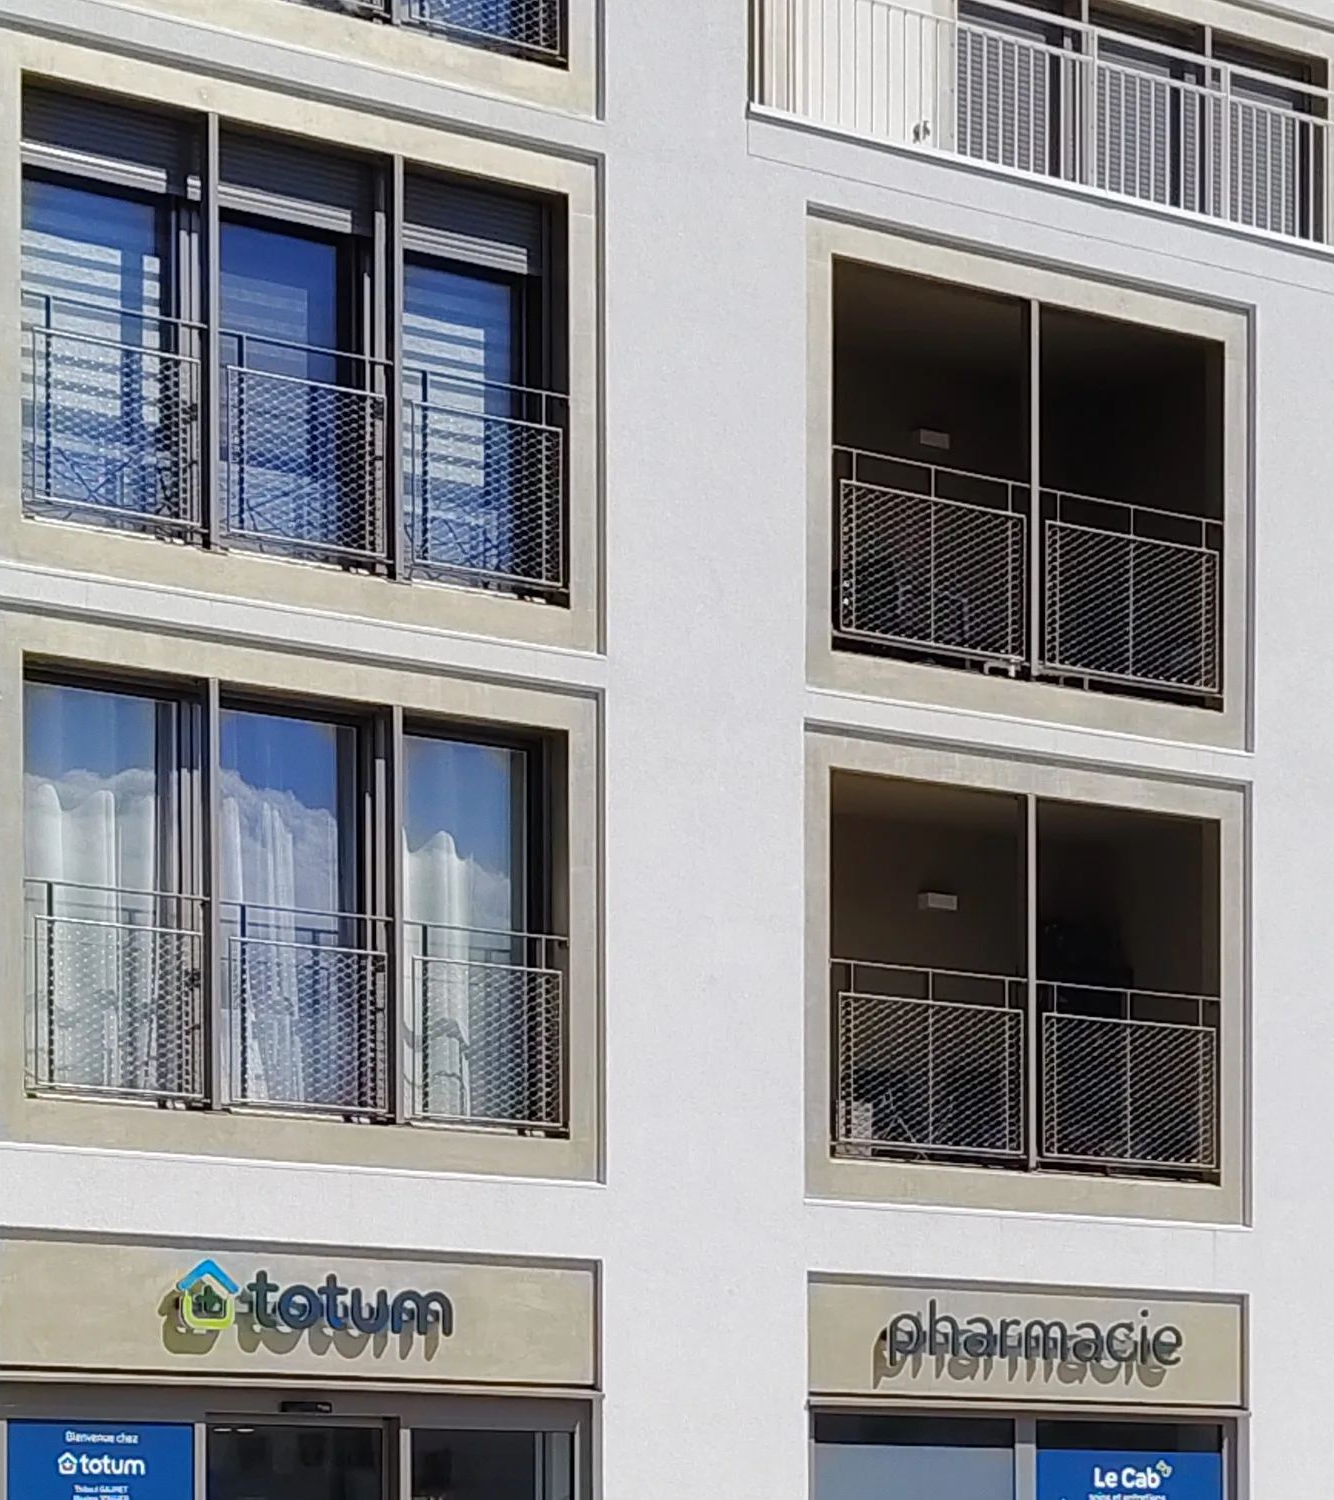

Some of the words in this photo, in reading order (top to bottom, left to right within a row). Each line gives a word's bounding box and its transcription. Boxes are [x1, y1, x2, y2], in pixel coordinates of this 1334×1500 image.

[247, 1270, 453, 1337] totum
[888, 1298, 1183, 1367] pharmacie
[79, 1453, 146, 1475] totum
[1094, 1466, 1117, 1488] Le
[1121, 1466, 1161, 1489] Cab
